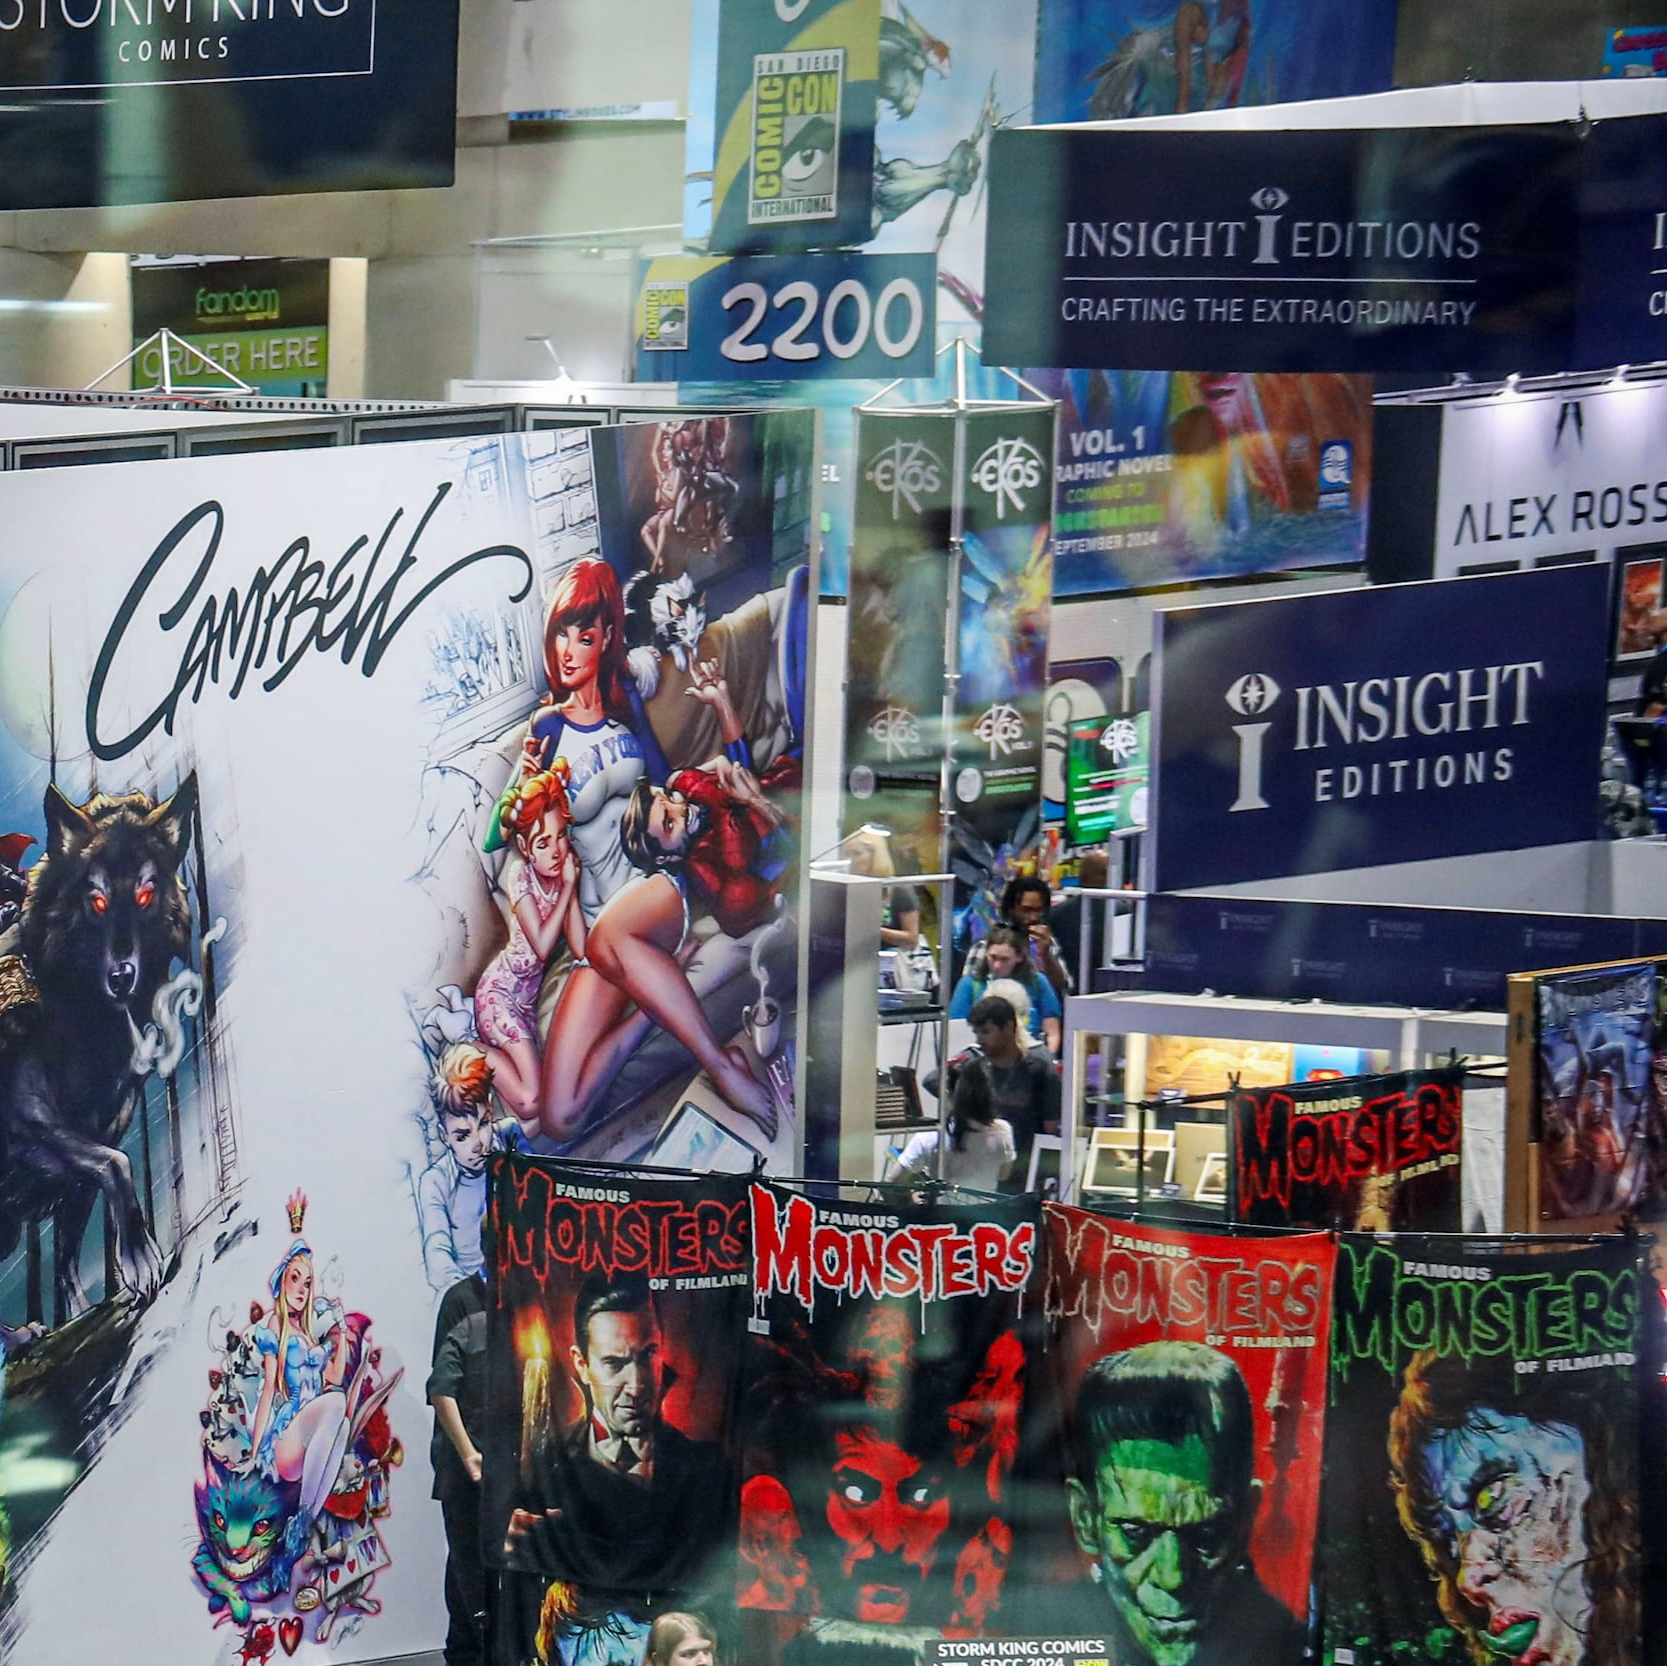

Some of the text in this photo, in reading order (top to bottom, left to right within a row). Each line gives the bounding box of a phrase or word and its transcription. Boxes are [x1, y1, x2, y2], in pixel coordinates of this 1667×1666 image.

[119, 37, 231, 63] COMICS
[756, 52, 841, 72] SAN DIEGO
[788, 72, 837, 114] CON
[754, 77, 784, 198] COMIC
[751, 195, 835, 220] INTERNATIONAL
[1065, 220, 1481, 260] INSIGHT EDITIONS
[196, 286, 280, 320] fandom
[720, 277, 924, 363] 2200
[1062, 297, 1477, 326] CRAFTING THE EXTRAORDINARY
[142, 335, 320, 381] ORDER HERE
[1071, 426, 1145, 456] VOL. 1
[1119, 455, 1172, 475] NOVEL
[1454, 481, 1667, 546] ALEX ROSS
[1294, 662, 1544, 750] INSIGHT
[1315, 748, 1514, 803] EDITIONS
[1294, 1097, 1362, 1116] FAMOUS
[1237, 1083, 1462, 1205] MONSTERS
[556, 1185, 630, 1204] FAMOUS
[495, 1166, 747, 1290] MONSTERS
[819, 1211, 899, 1228] FAMOUS
[750, 1181, 1035, 1315] MONSTERS
[1112, 1234, 1191, 1258] FAMOUS
[1044, 1212, 1319, 1335] MONSTERS
[1404, 1261, 1491, 1280] FAMOUS
[1335, 1242, 1637, 1372] MONSTERS
[1206, 1334, 1316, 1348] OF FILMLAND
[938, 1640, 1105, 1657] STORM KING COMICS
